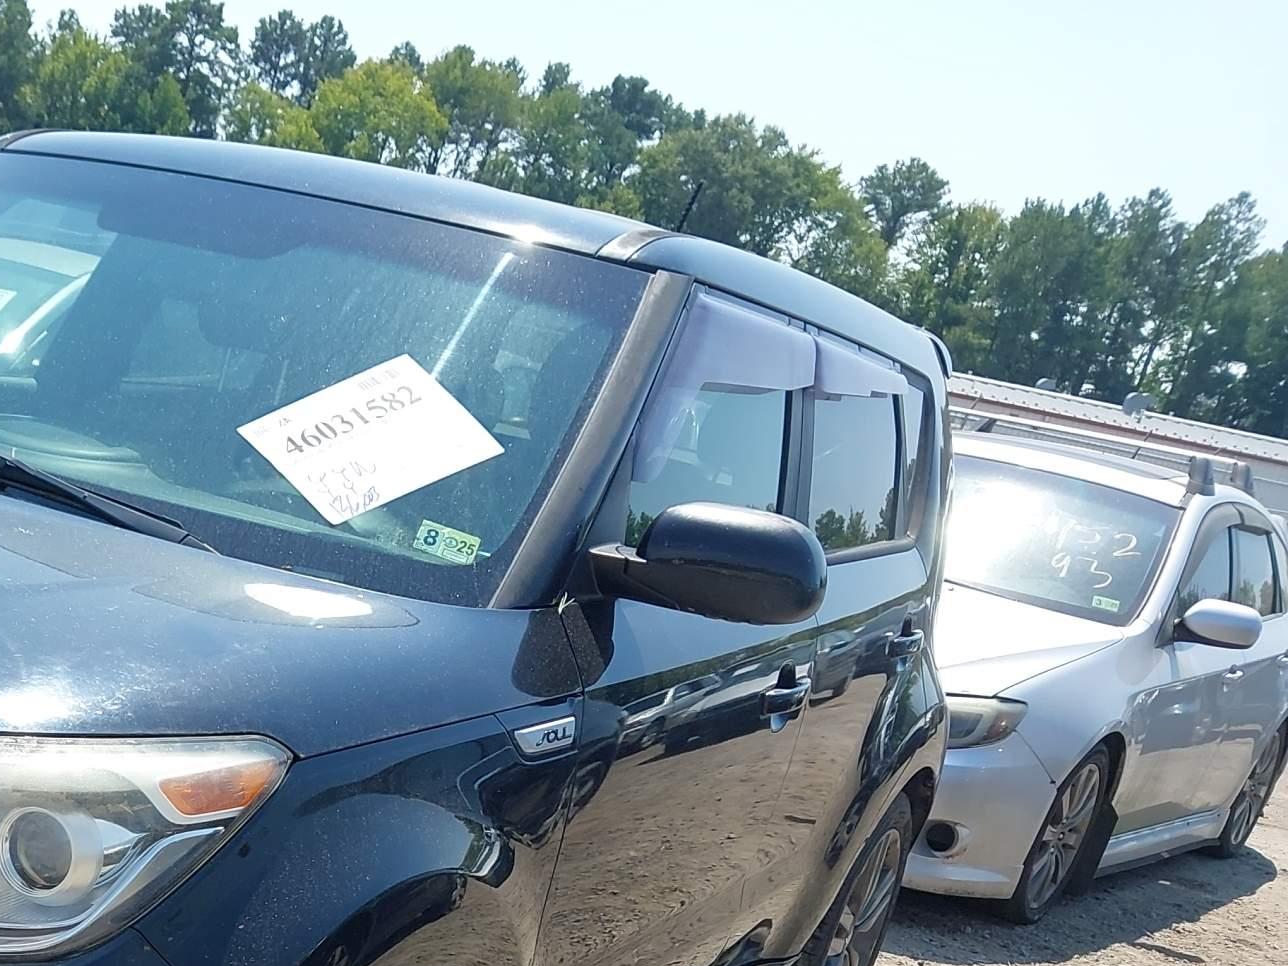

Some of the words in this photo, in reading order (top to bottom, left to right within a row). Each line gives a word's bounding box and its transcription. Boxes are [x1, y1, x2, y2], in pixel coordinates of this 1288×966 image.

[286, 386, 422, 454] 46031582
[423, 529, 440, 546] 8
[456, 540, 476, 556] 25
[536, 726, 573, 747] SOUL
